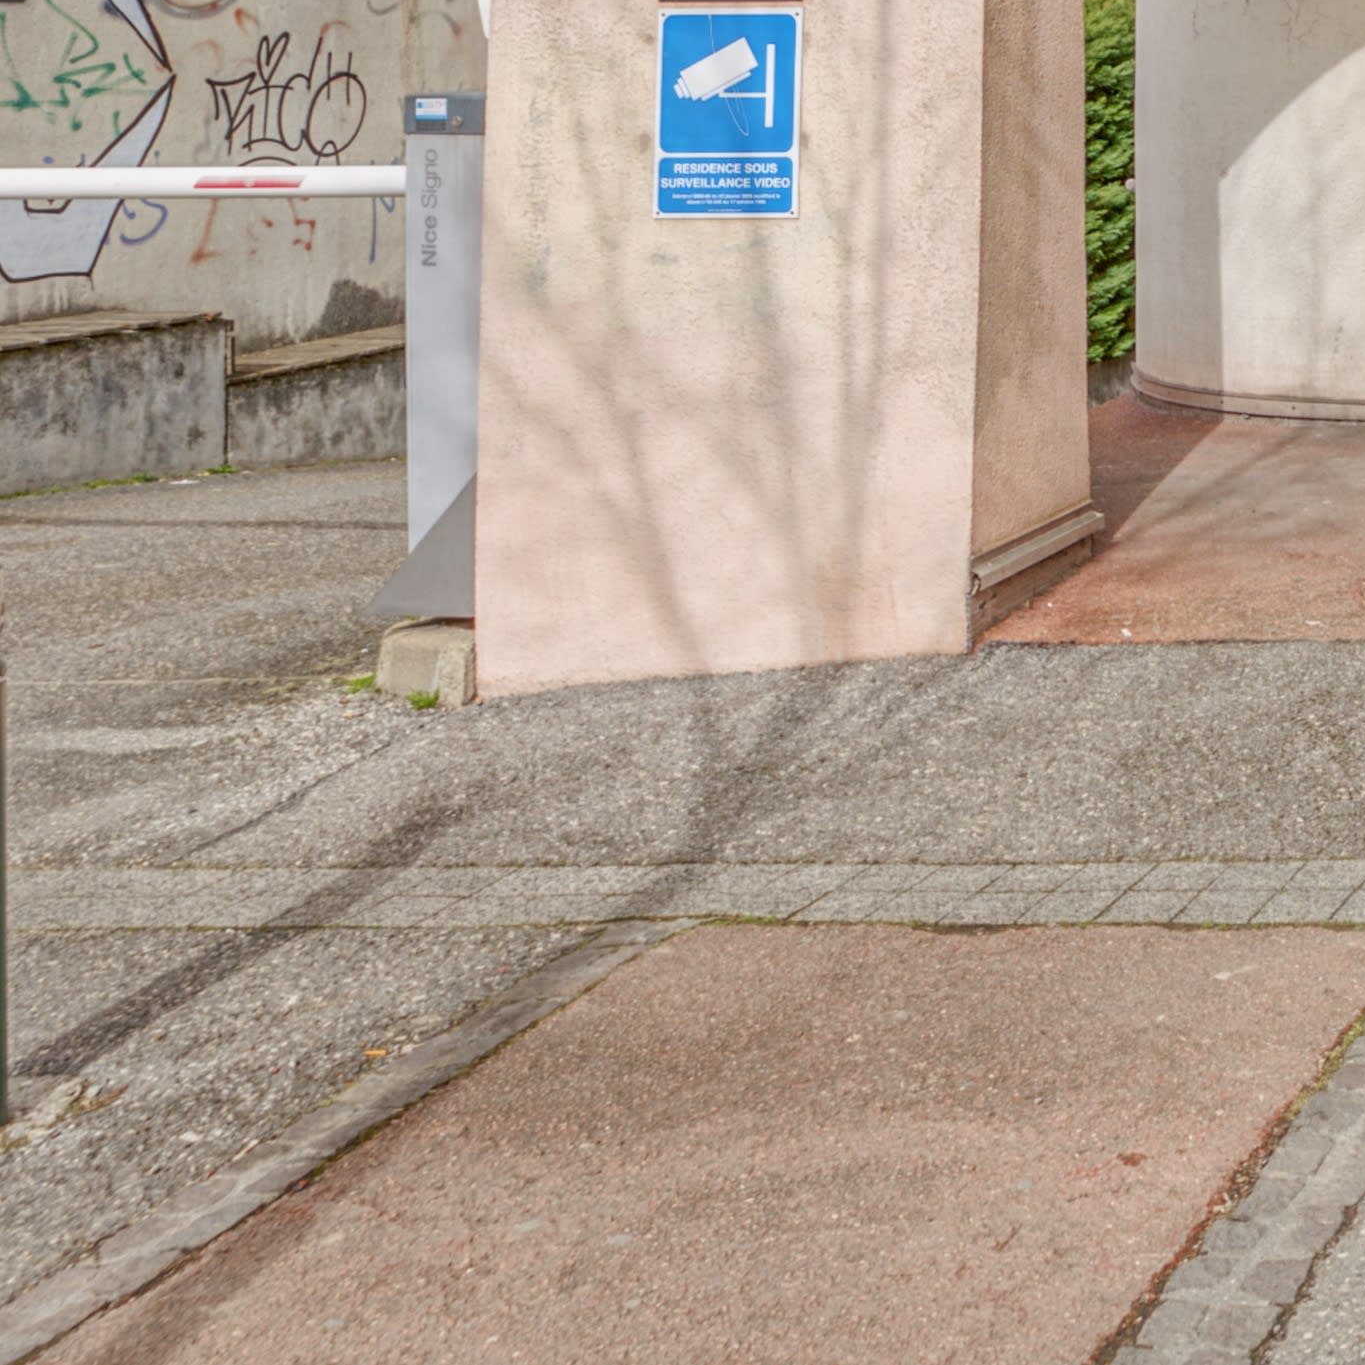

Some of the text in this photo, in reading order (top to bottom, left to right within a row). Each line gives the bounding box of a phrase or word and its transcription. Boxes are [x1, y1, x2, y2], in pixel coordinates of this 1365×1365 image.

[673, 162, 779, 175] RESIDENCE SOUS
[660, 177, 791, 189] SURVEILLANCE VIDEO
[420, 148, 442, 268] Nice Signo
